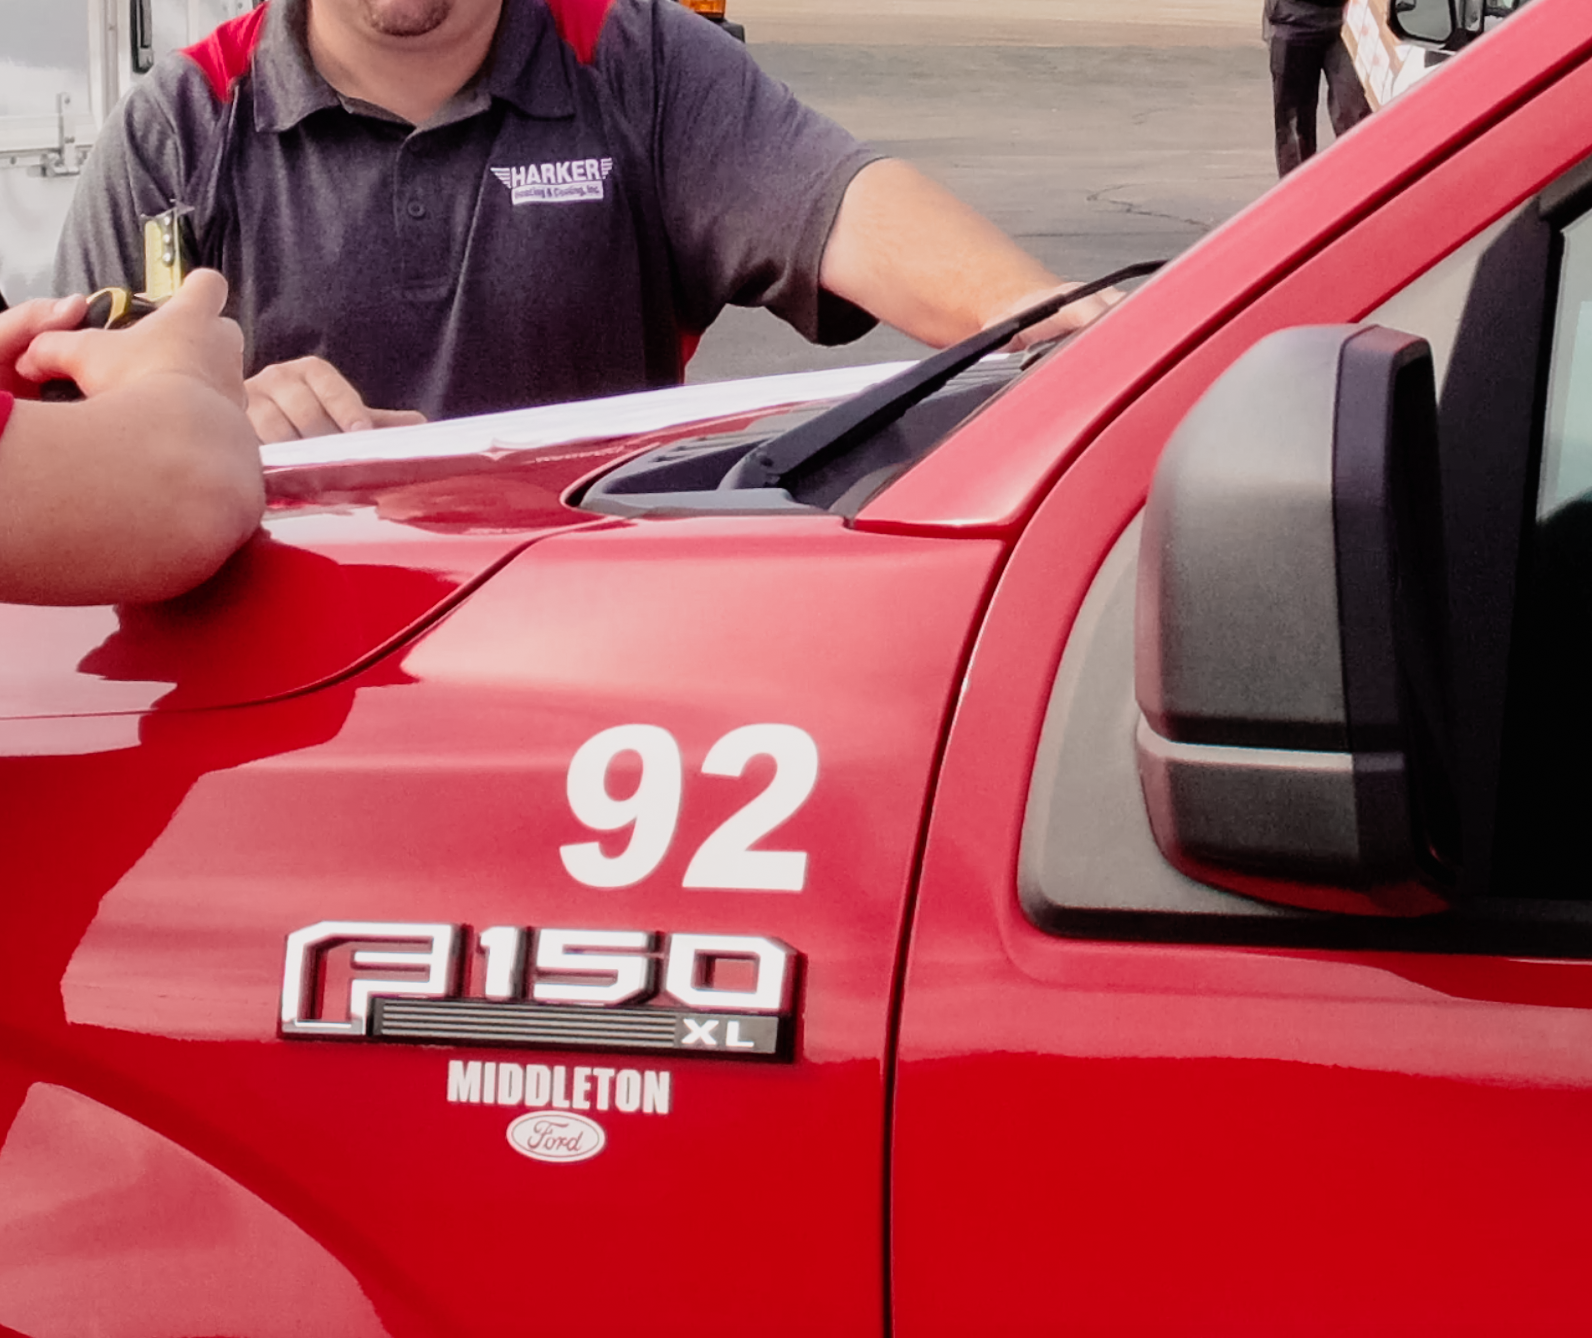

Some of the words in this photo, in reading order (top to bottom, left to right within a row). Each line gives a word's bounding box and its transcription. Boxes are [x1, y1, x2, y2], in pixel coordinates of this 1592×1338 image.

[511, 159, 601, 187] HARKER
[559, 723, 819, 893] 92
[681, 1017, 755, 1049] XL
[447, 1059, 671, 1115] MIDDLETON
[527, 1122, 585, 1155] Ford
